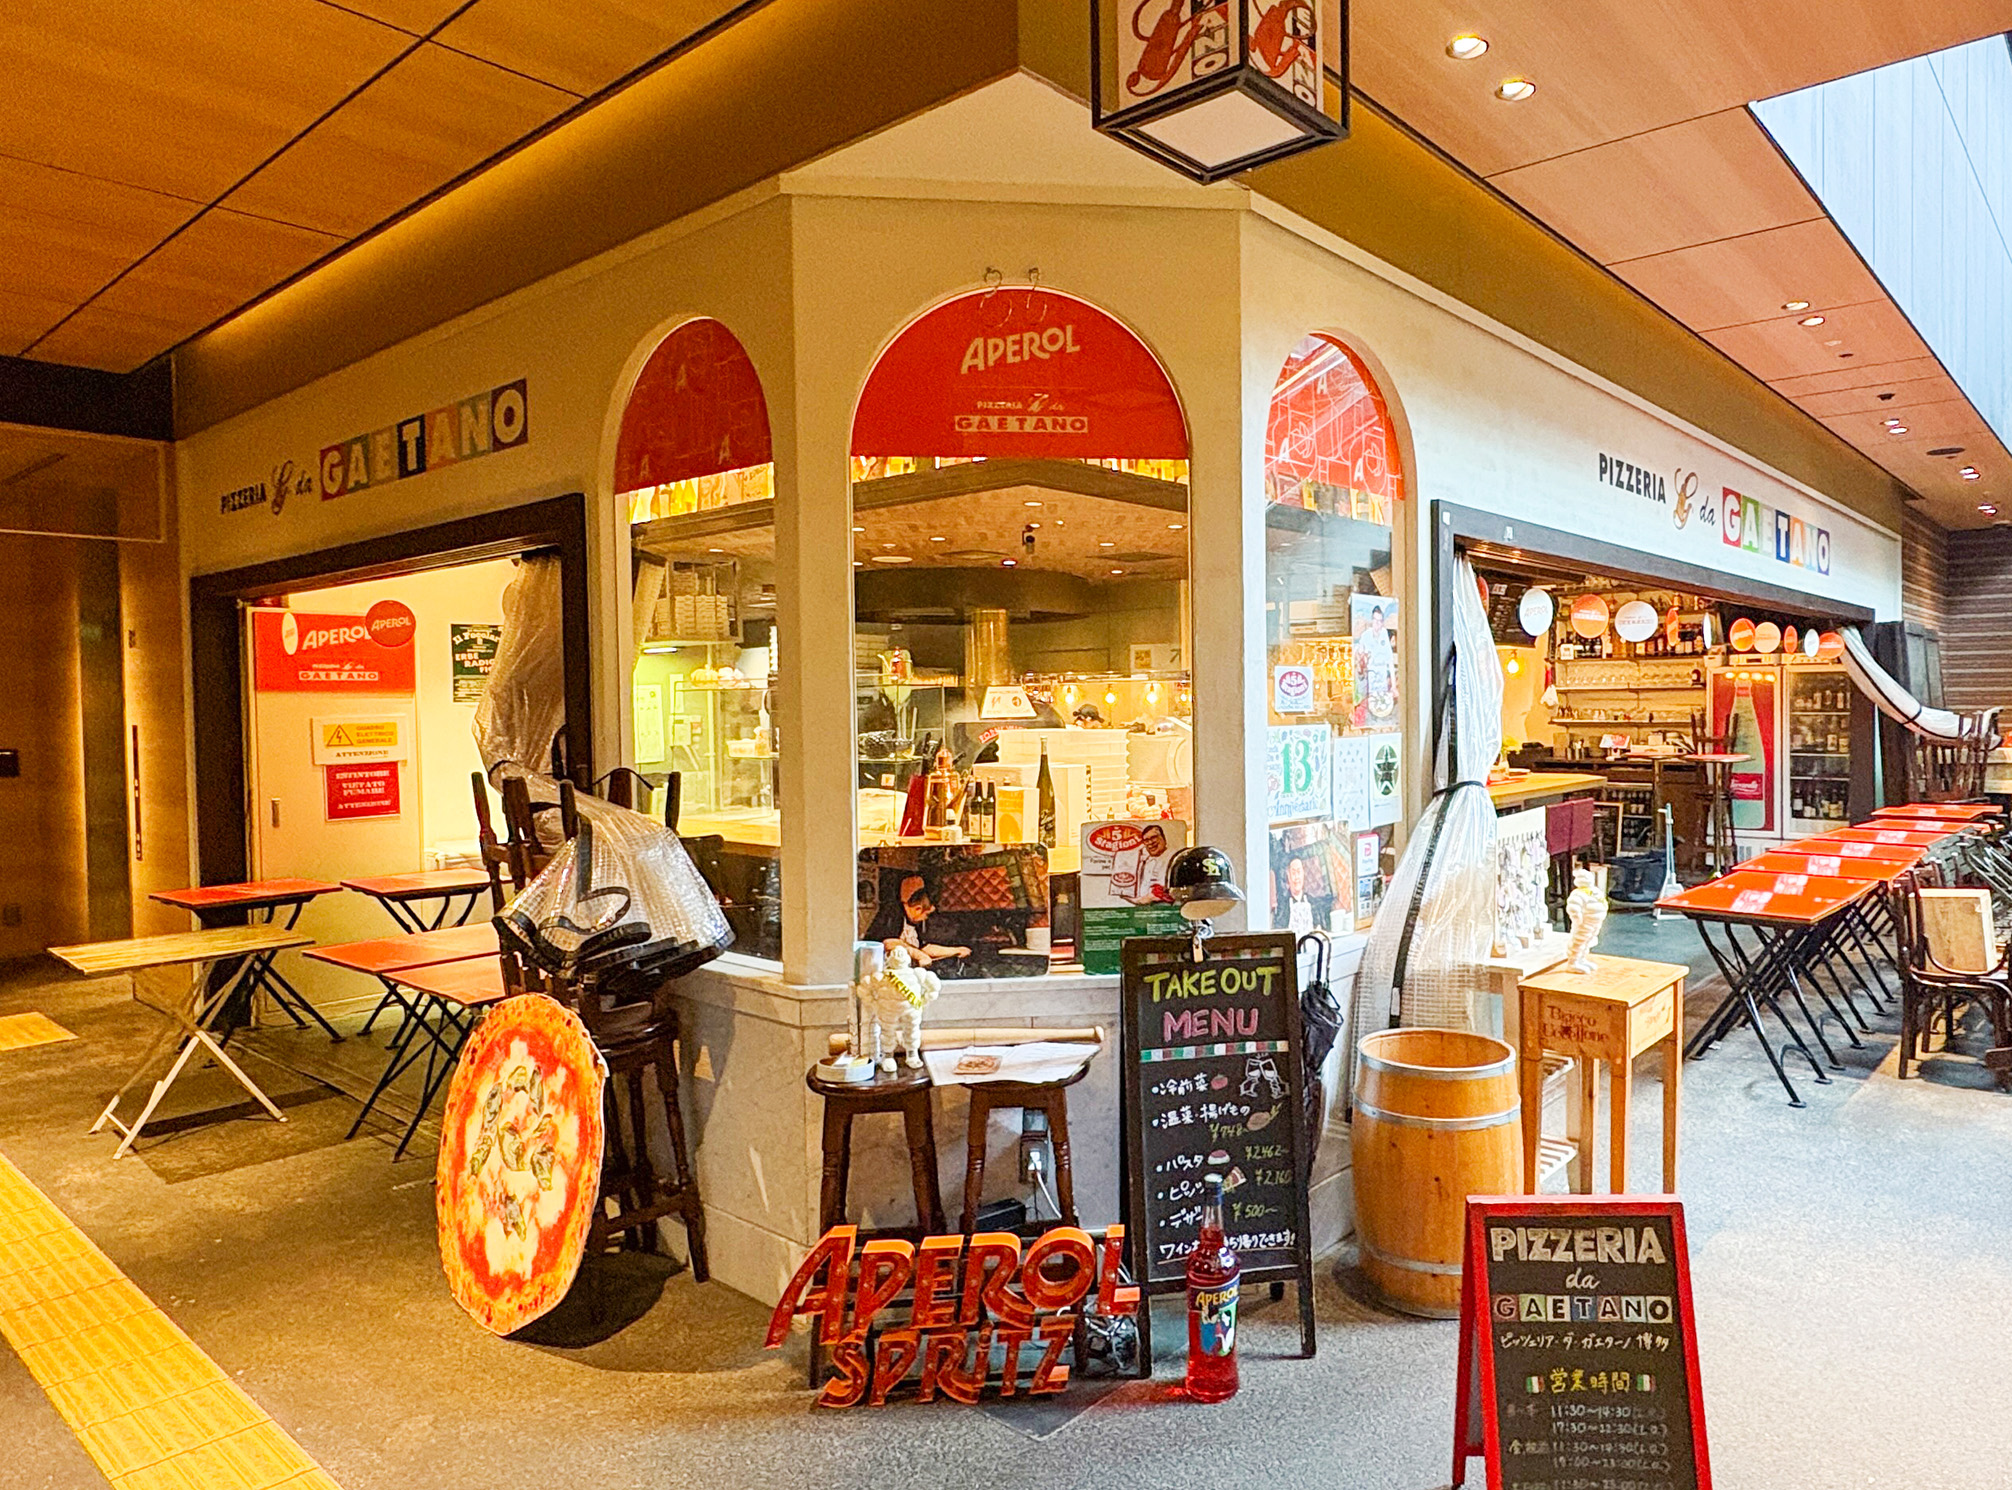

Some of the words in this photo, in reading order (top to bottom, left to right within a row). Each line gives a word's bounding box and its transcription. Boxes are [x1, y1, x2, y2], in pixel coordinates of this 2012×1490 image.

[960, 325, 1080, 374] APEROL
[977, 401, 1023, 410] PIZZERIA
[955, 416, 1087, 432] GAETANO
[220, 482, 267, 515] PIZZERIA
[296, 470, 312, 496] da
[321, 385, 526, 498] GAETANO
[1599, 452, 1667, 505] PIZZERIA
[1700, 496, 1717, 527] da
[1723, 490, 1830, 576] GAETANO
[371, 616, 412, 632] APEROL
[455, 652, 480, 661] ERBE
[299, 672, 379, 681] GAETANO
[335, 750, 389, 758] ATTENZIONE
[1280, 740, 1312, 795] 13
[342, 780, 386, 788] VIETATO
[343, 787, 385, 796] FUMARE
[337, 800, 391, 810] ATTENZIONE
[1094, 836, 1142, 852] Stagioni
[1111, 829, 1122, 841] 5
[1143, 969, 1217, 1002] TAKE
[1220, 966, 1282, 997] OUT
[1163, 1007, 1259, 1043] MENU
[1166, 1155, 1203, 1171] パスタ
[1490, 1227, 1667, 1264] PIZZERIA
[764, 1224, 1140, 1350] APEROL
[1566, 1267, 1600, 1289] da
[1195, 1285, 1238, 1308] APEROL
[1495, 1296, 1671, 1322] GAETANO
[1636, 1331, 1670, 1352] 博多
[818, 1313, 1077, 1407] SPRITZ
[1550, 1367, 1630, 1395] 営業時間
